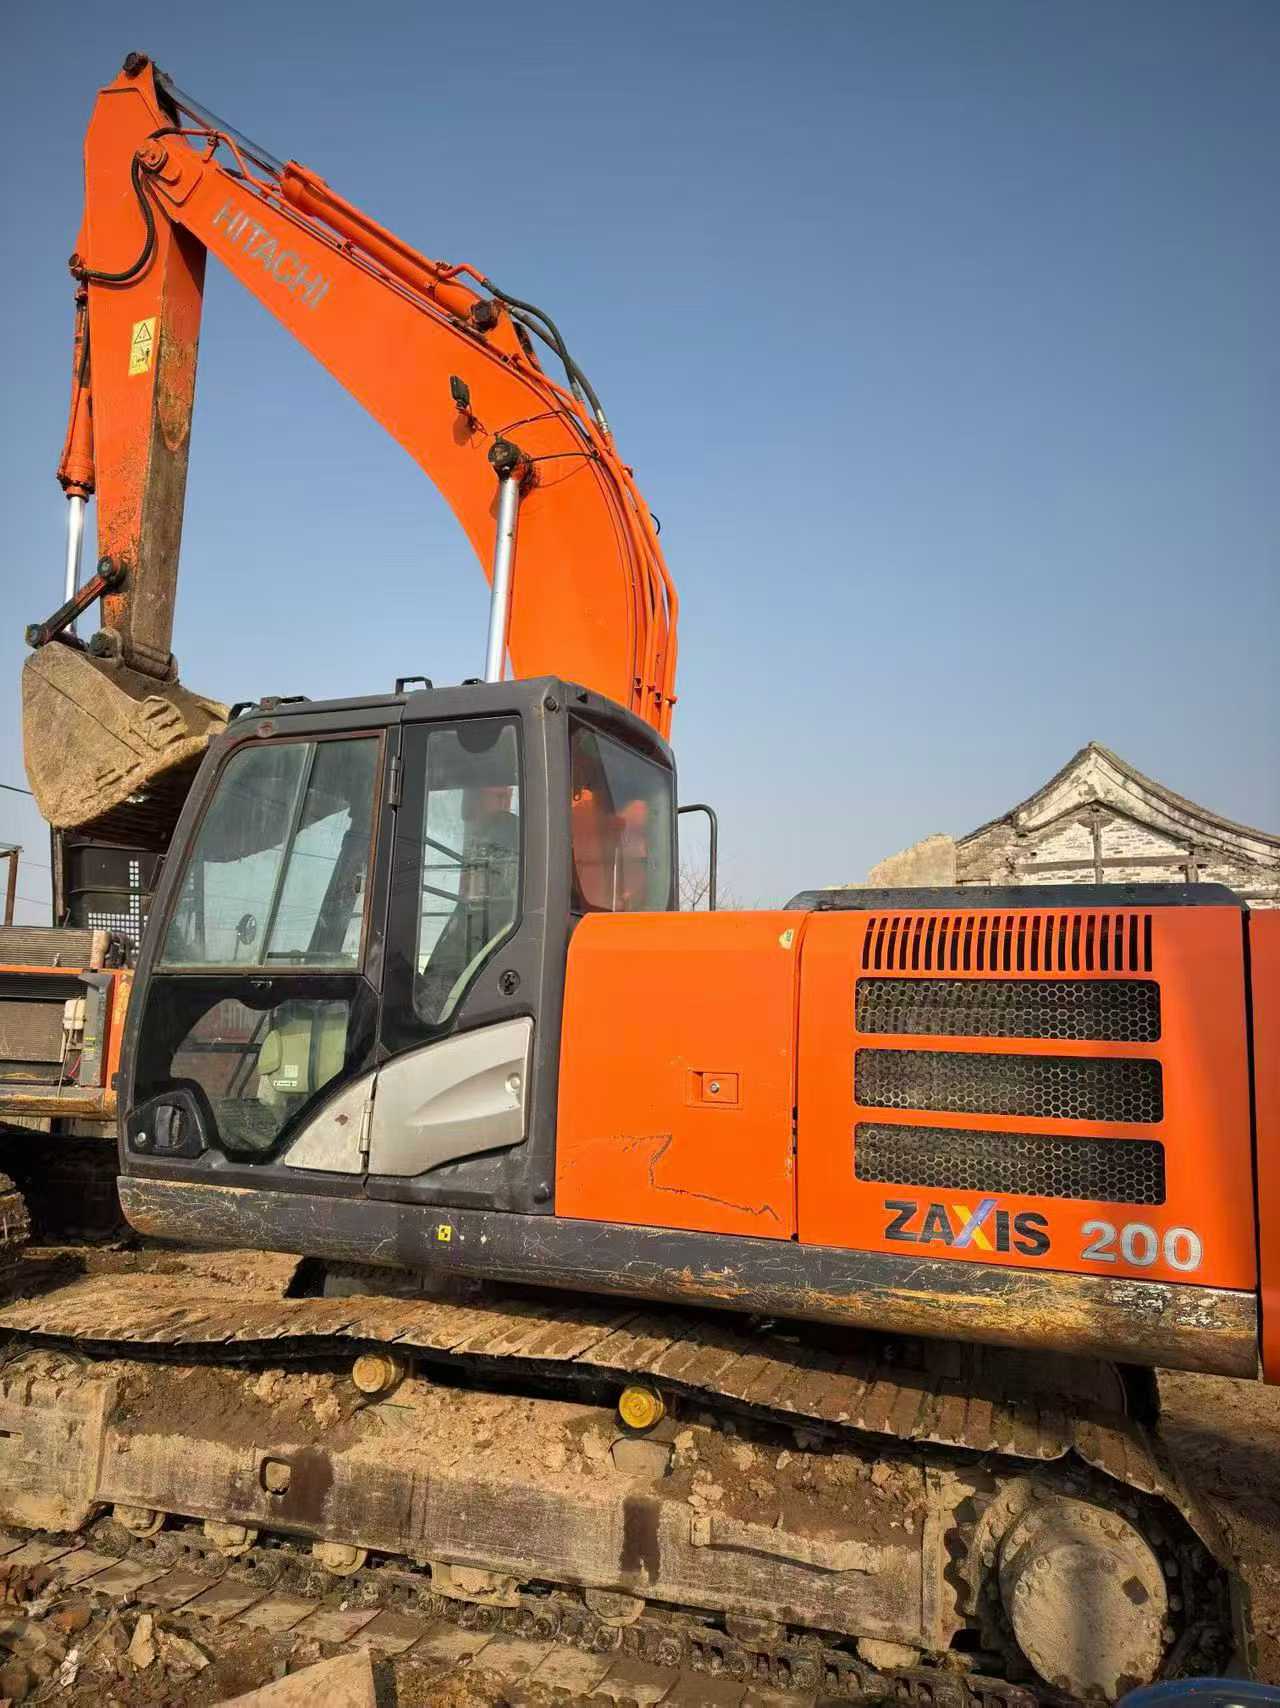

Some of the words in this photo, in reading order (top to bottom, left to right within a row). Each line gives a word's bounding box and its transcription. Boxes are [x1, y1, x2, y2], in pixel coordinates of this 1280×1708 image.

[211, 197, 330, 310] HITACHI
[883, 1199, 1051, 1257] ZAXIS
[1080, 1220, 1203, 1273] 200
